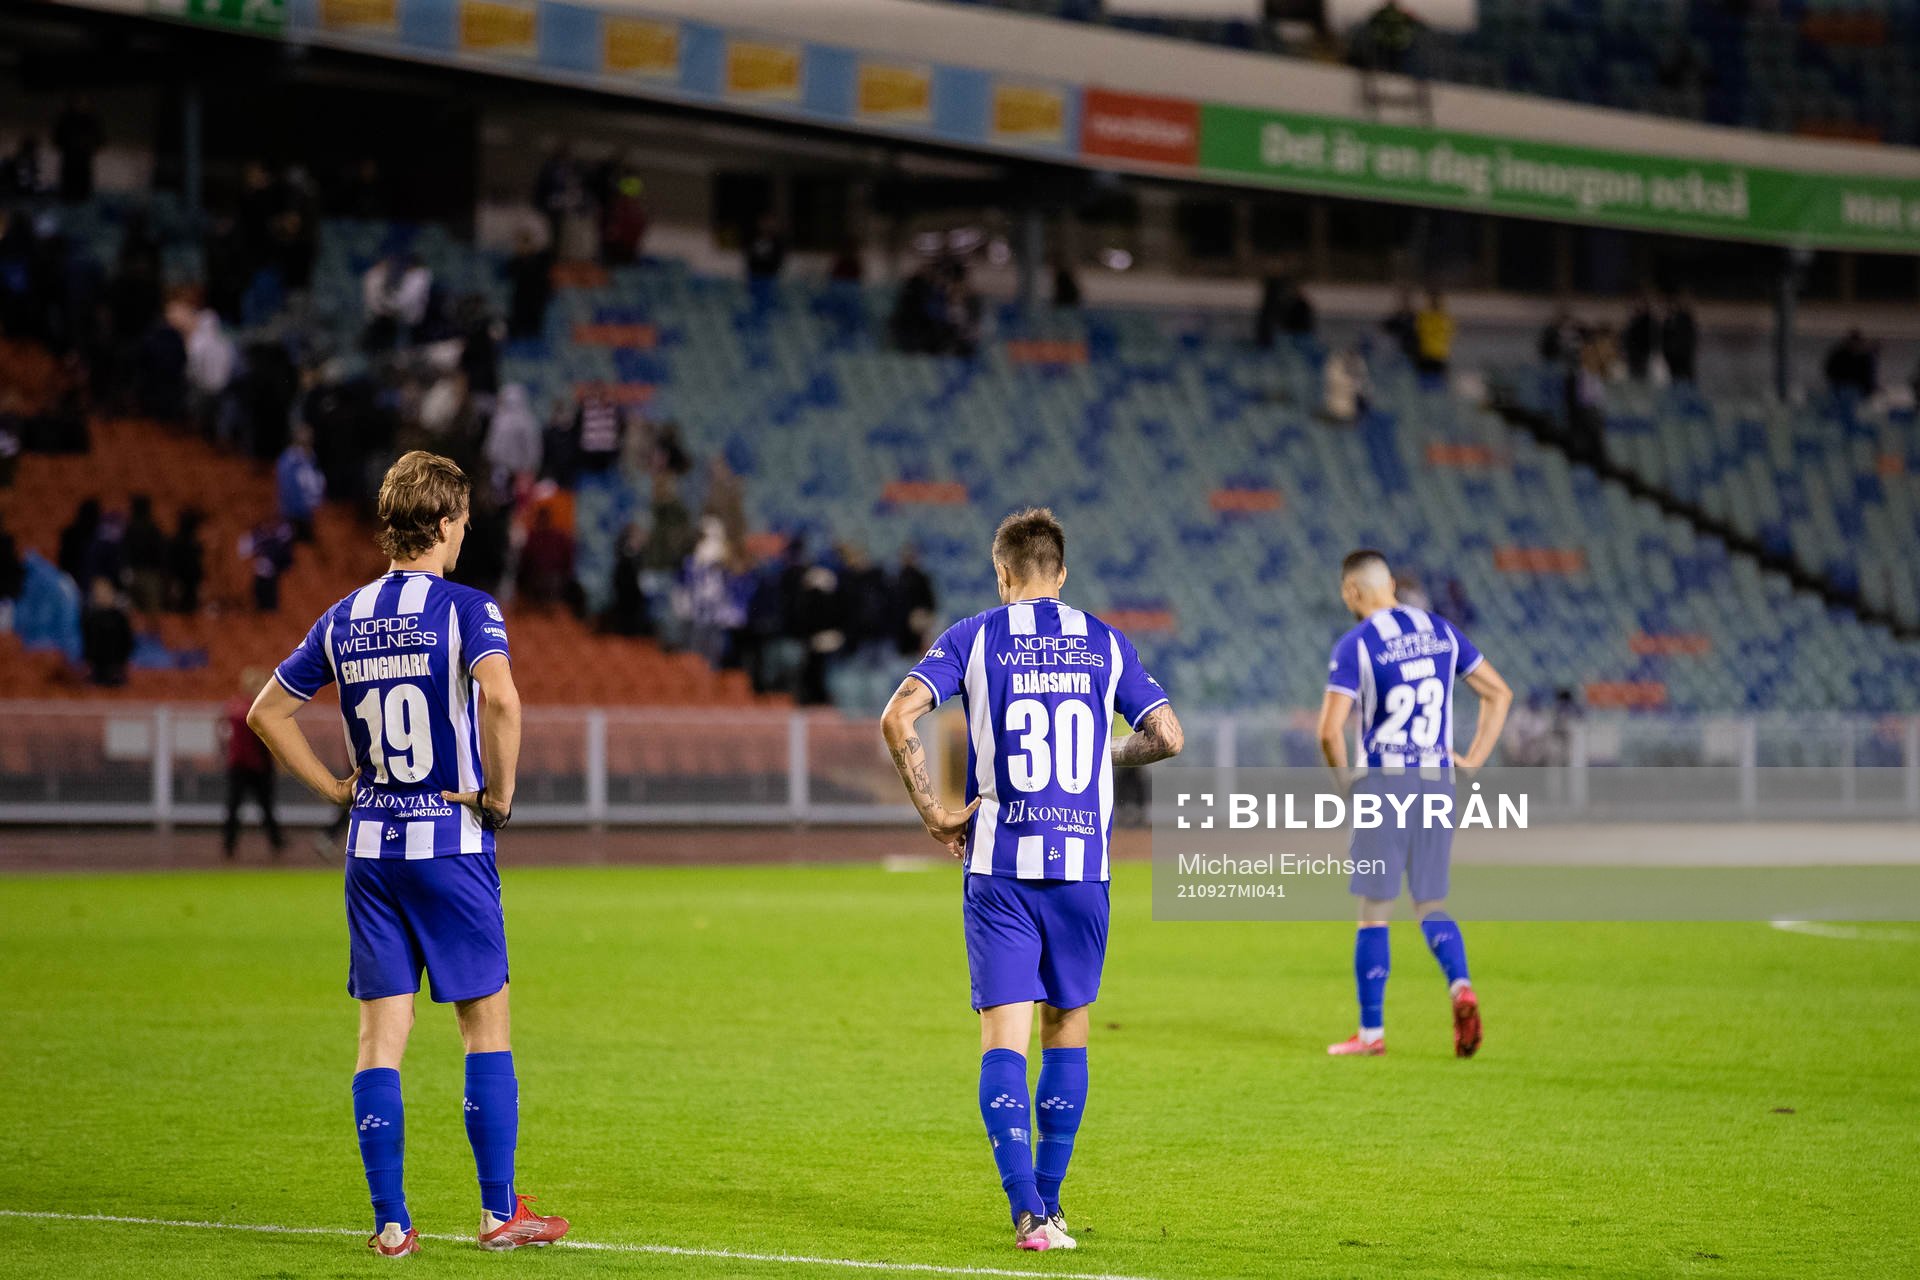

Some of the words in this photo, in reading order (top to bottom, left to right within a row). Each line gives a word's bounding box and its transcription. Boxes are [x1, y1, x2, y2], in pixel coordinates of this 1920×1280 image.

[1260, 122, 1325, 170] Det
[1331, 129, 1368, 174] är
[1373, 143, 1419, 181] en
[1426, 142, 1490, 199] dag
[1496, 146, 1643, 213] imorgon
[1649, 164, 1748, 219] också
[350, 616, 419, 636] NORDIC
[338, 631, 437, 656] WELLNESS
[1014, 637, 1087, 650] NORDIC
[341, 653, 431, 685] ERLINGMARK
[996, 651, 1104, 667] WELLNESS
[1013, 670, 1091, 694] BJÄRSMYR
[1375, 677, 1444, 747] 23
[355, 683, 433, 784] 19
[1006, 699, 1095, 794] 30
[412, 808, 453, 817] INSTALCO
[1004, 800, 1026, 824] El
[1027, 806, 1097, 826] KONTAKT
